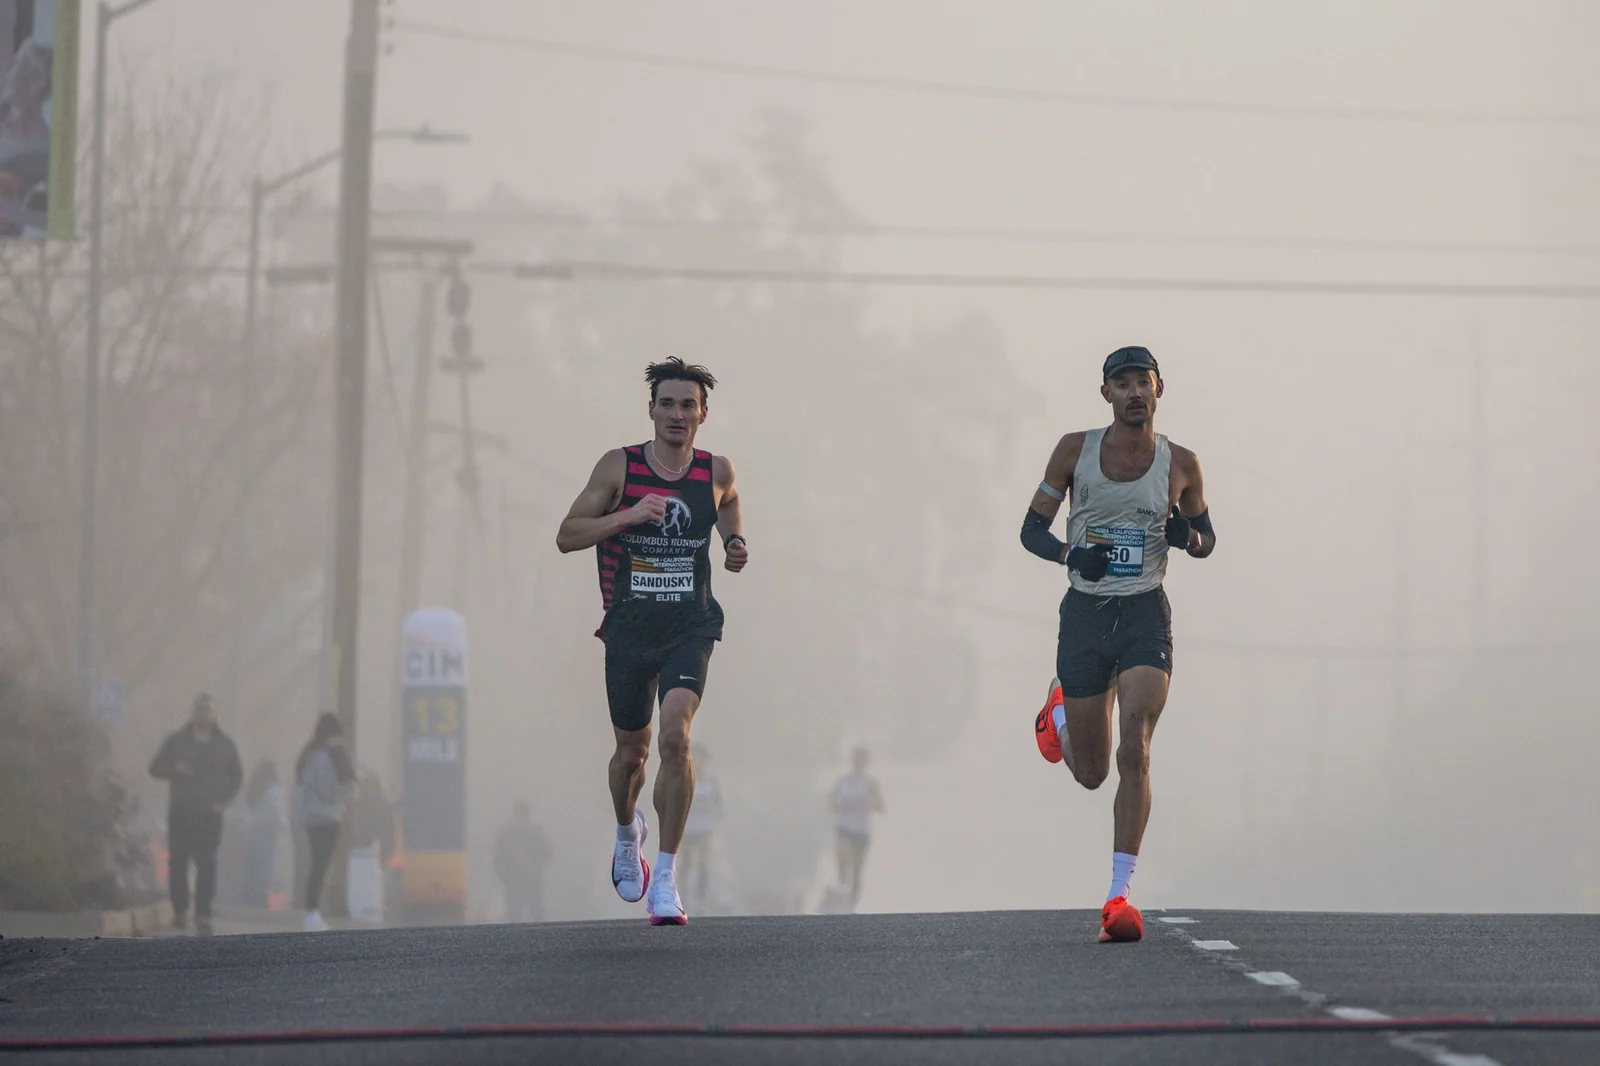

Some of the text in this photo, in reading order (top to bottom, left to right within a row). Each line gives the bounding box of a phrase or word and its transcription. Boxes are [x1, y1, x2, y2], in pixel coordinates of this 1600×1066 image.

[620, 533, 669, 547] COLUMBUS
[642, 546, 686, 554] COMPANY
[632, 575, 693, 588] SANDUSKY
[655, 593, 682, 602] ELITE
[411, 698, 459, 734] 13
